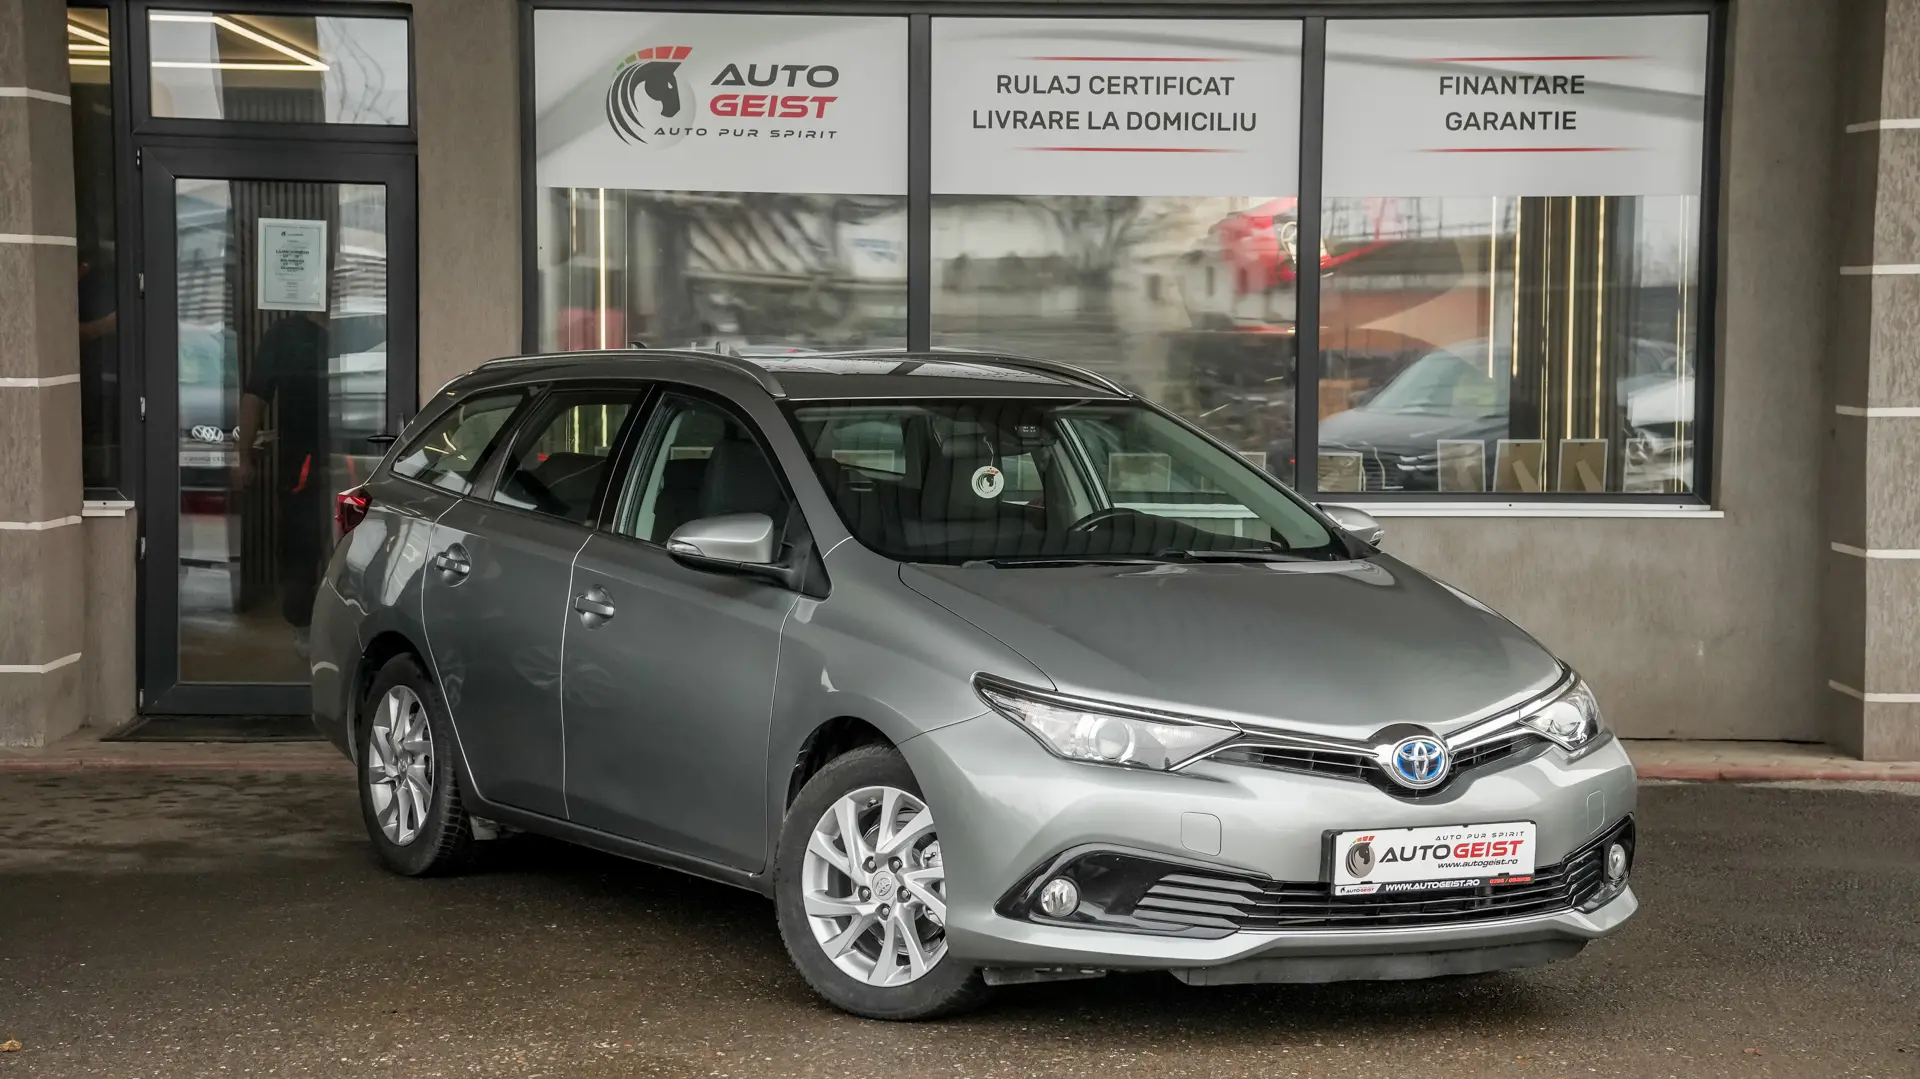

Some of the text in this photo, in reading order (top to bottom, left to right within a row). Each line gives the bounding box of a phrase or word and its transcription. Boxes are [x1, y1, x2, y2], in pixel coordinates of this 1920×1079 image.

[709, 63, 840, 88] AUTO
[996, 74, 1235, 96] RULAJ CERTIFICAT
[1439, 75, 1585, 95] FINANTARE
[709, 94, 839, 119] GEIST
[972, 109, 1257, 132] LIVRARE LA DOMICILIU
[1445, 110, 1577, 132] GARANTIE
[653, 127, 838, 139] AUTO PUR SPIRIT
[1466, 832, 1487, 840] PUR
[1437, 859, 1518, 869] www.autogeist.ro
[1386, 879, 1480, 891] WWW.AUTOGEIST.RO
